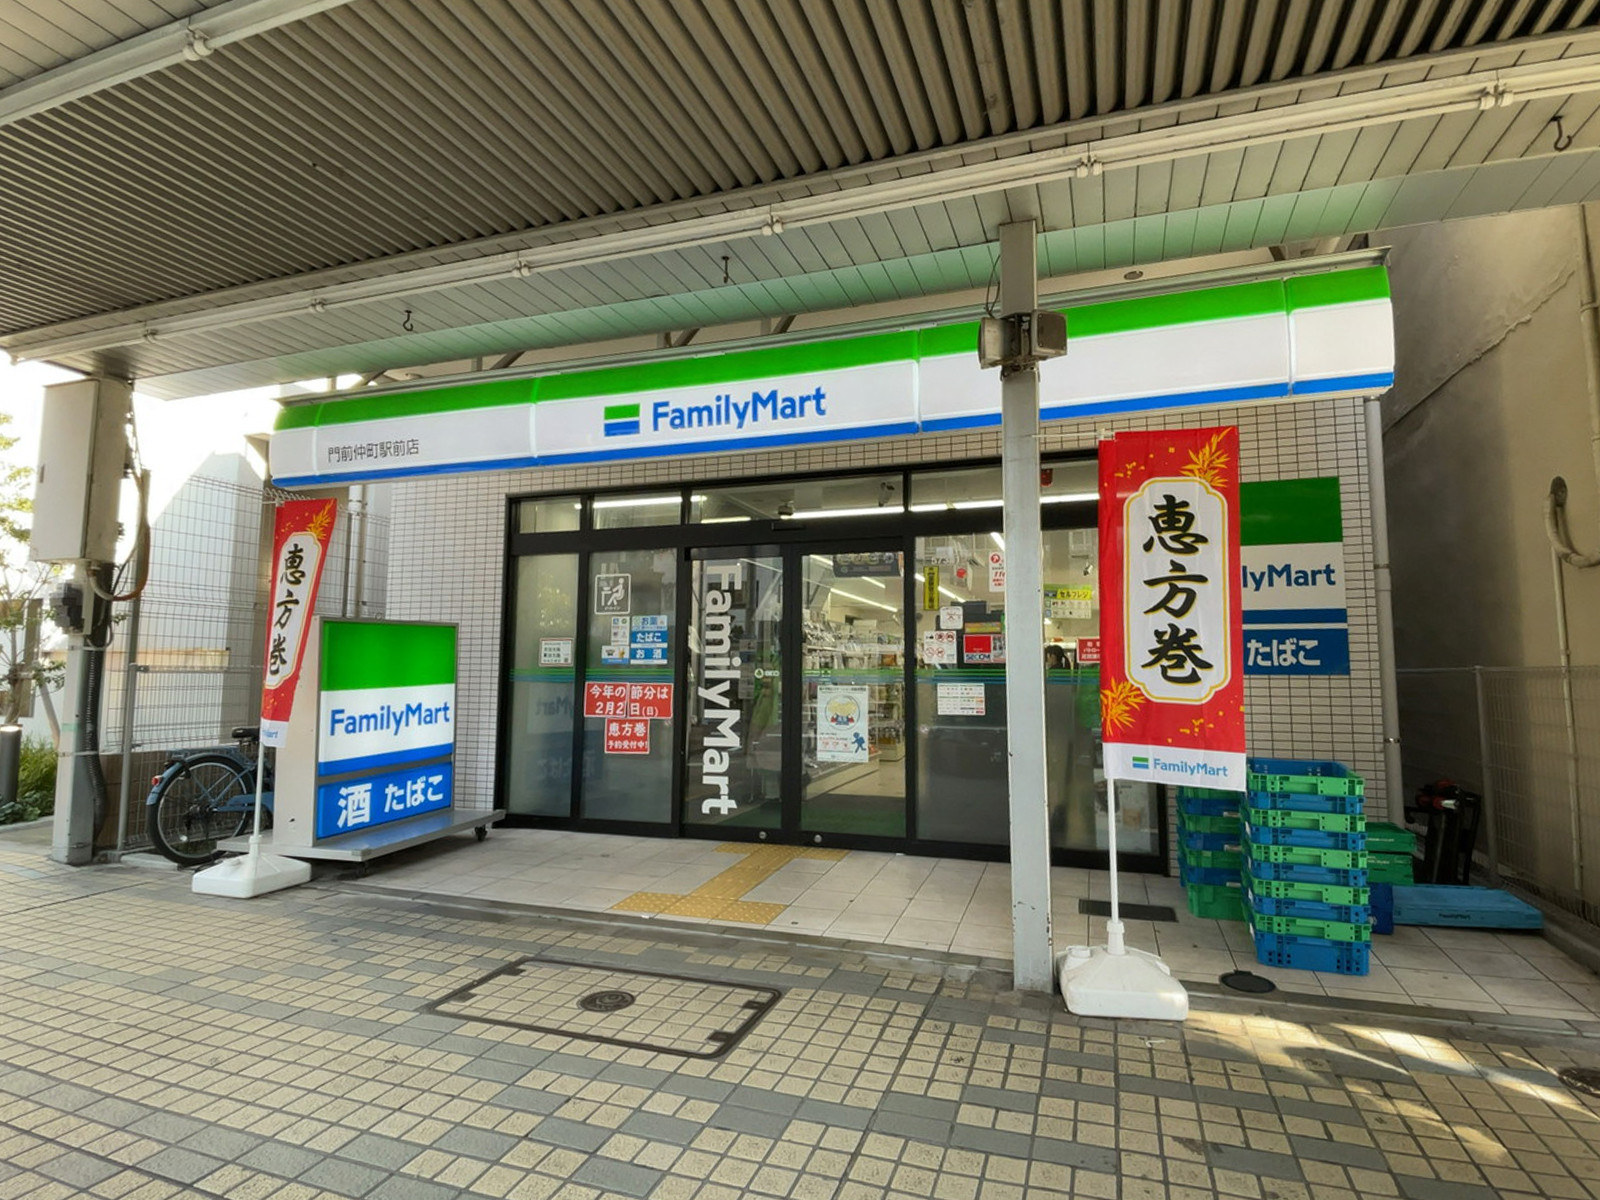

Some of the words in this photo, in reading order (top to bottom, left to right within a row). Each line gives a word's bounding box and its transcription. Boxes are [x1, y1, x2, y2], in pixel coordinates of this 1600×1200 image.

[652, 386, 827, 432] FamilyMart
[328, 438, 419, 463] 門前仲町駅前店
[1142, 494, 1214, 684] 恵方巻
[268, 543, 306, 676] 恵方巻
[636, 632, 662, 643] たばこ
[1246, 637, 1321, 667] たばこ
[589, 684, 669, 699] 今年の節分は
[697, 564, 742, 815] FamilyMart
[330, 701, 450, 736] FamilyMart
[608, 721, 646, 737] 恵方巻
[1153, 758, 1228, 777] FamilyMart
[336, 783, 372, 829] 酒
[384, 774, 443, 813] たばこ
